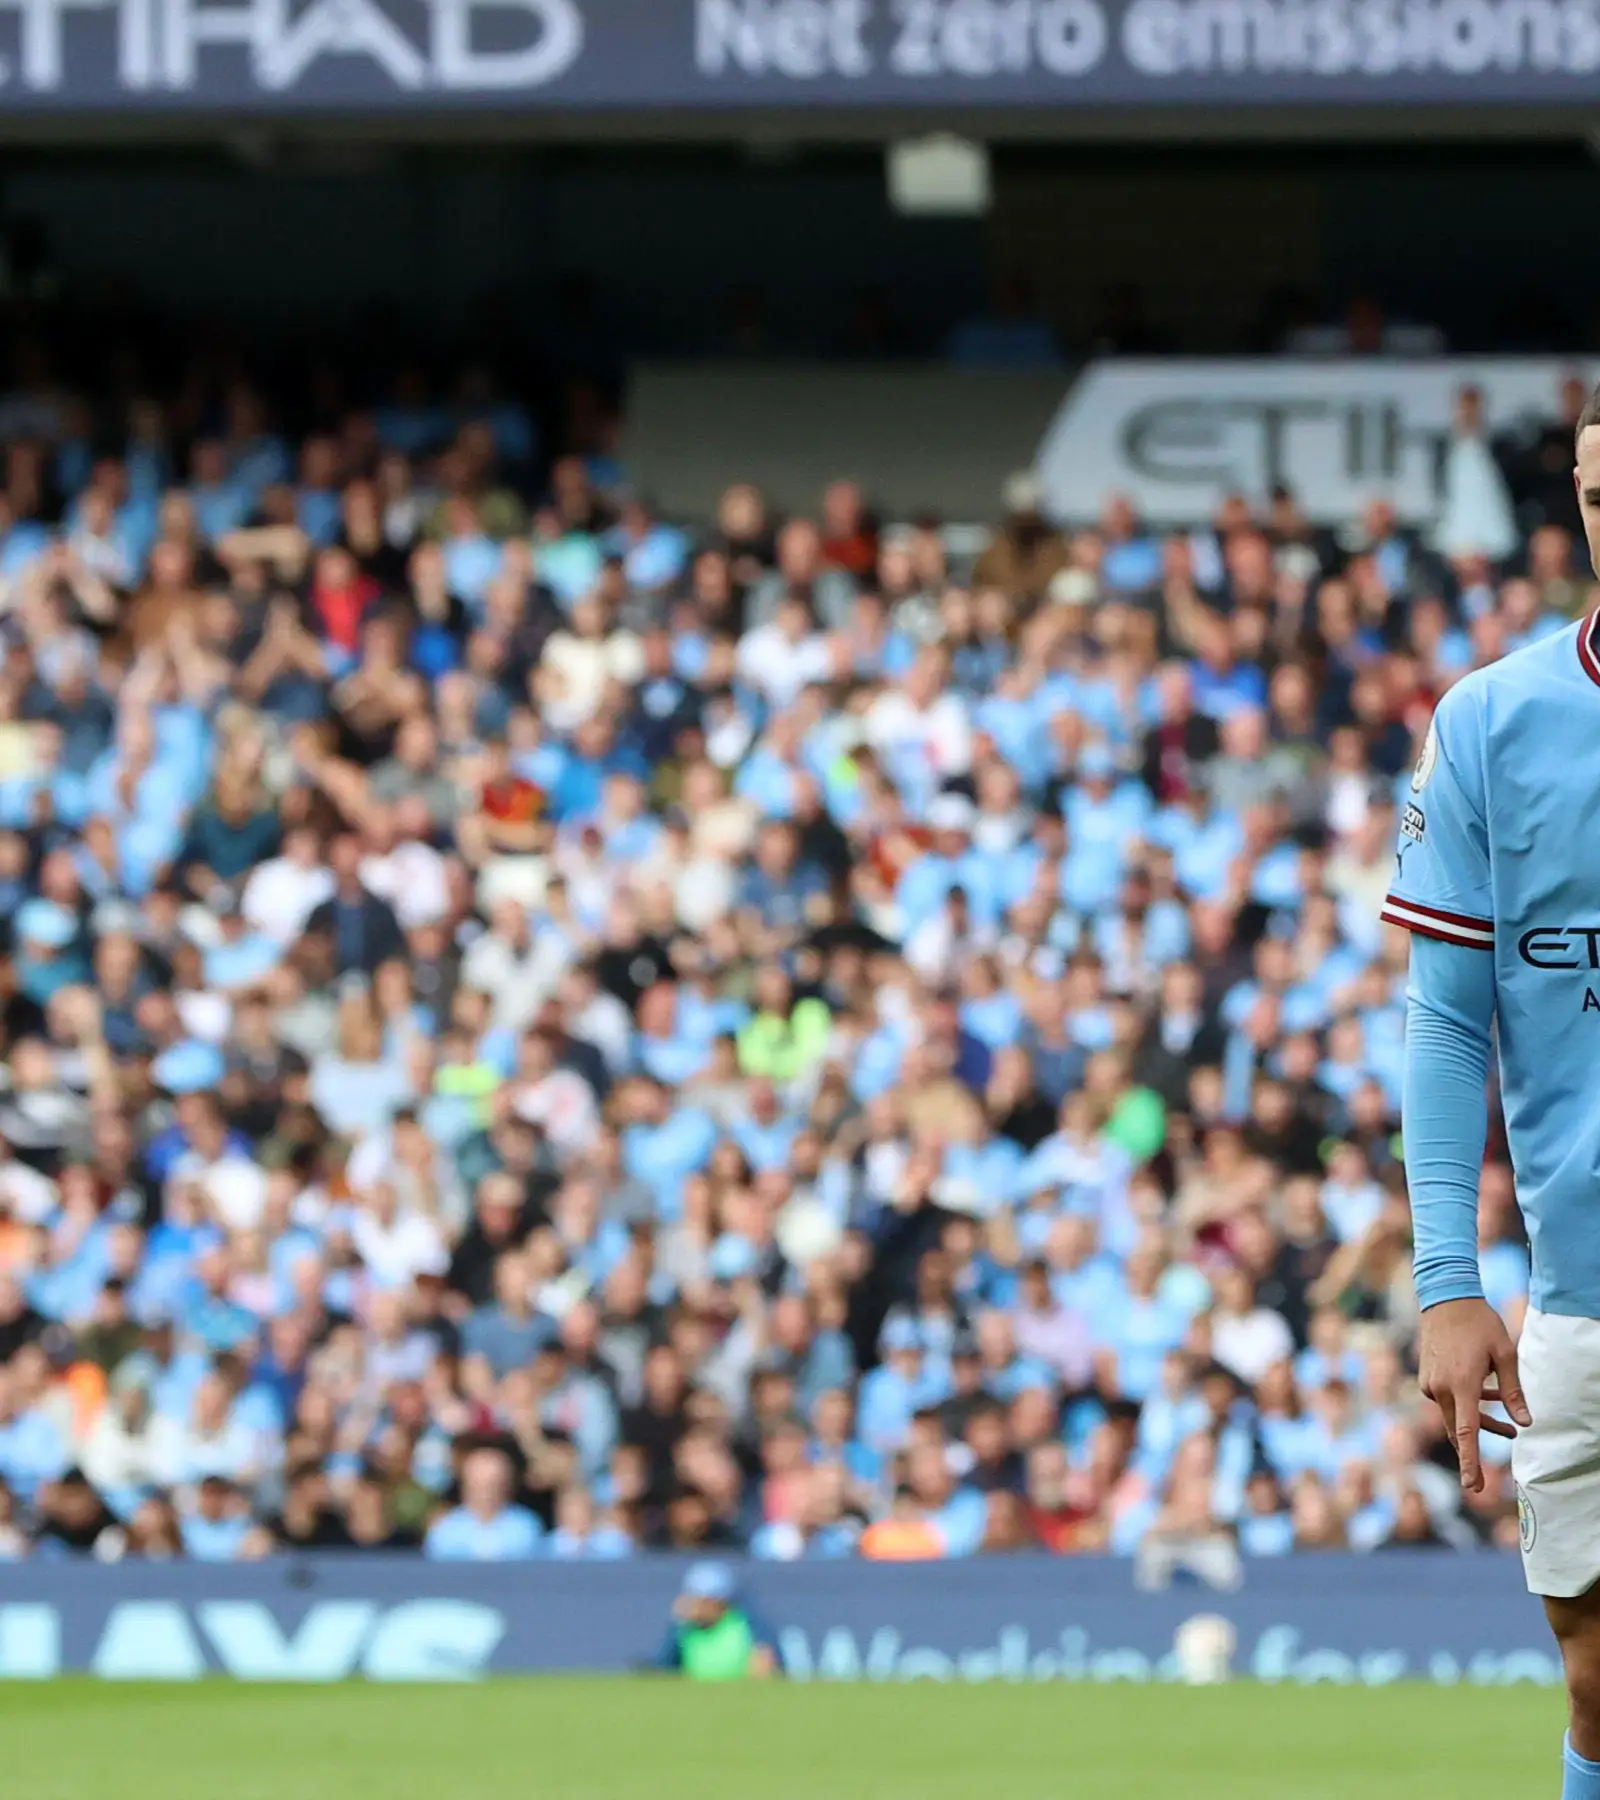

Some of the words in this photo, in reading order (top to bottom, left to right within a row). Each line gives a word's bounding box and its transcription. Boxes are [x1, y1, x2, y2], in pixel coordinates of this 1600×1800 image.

[0, 0, 583, 91] TIHAD
[695, 0, 870, 77] Net
[890, 0, 1107, 77] zero
